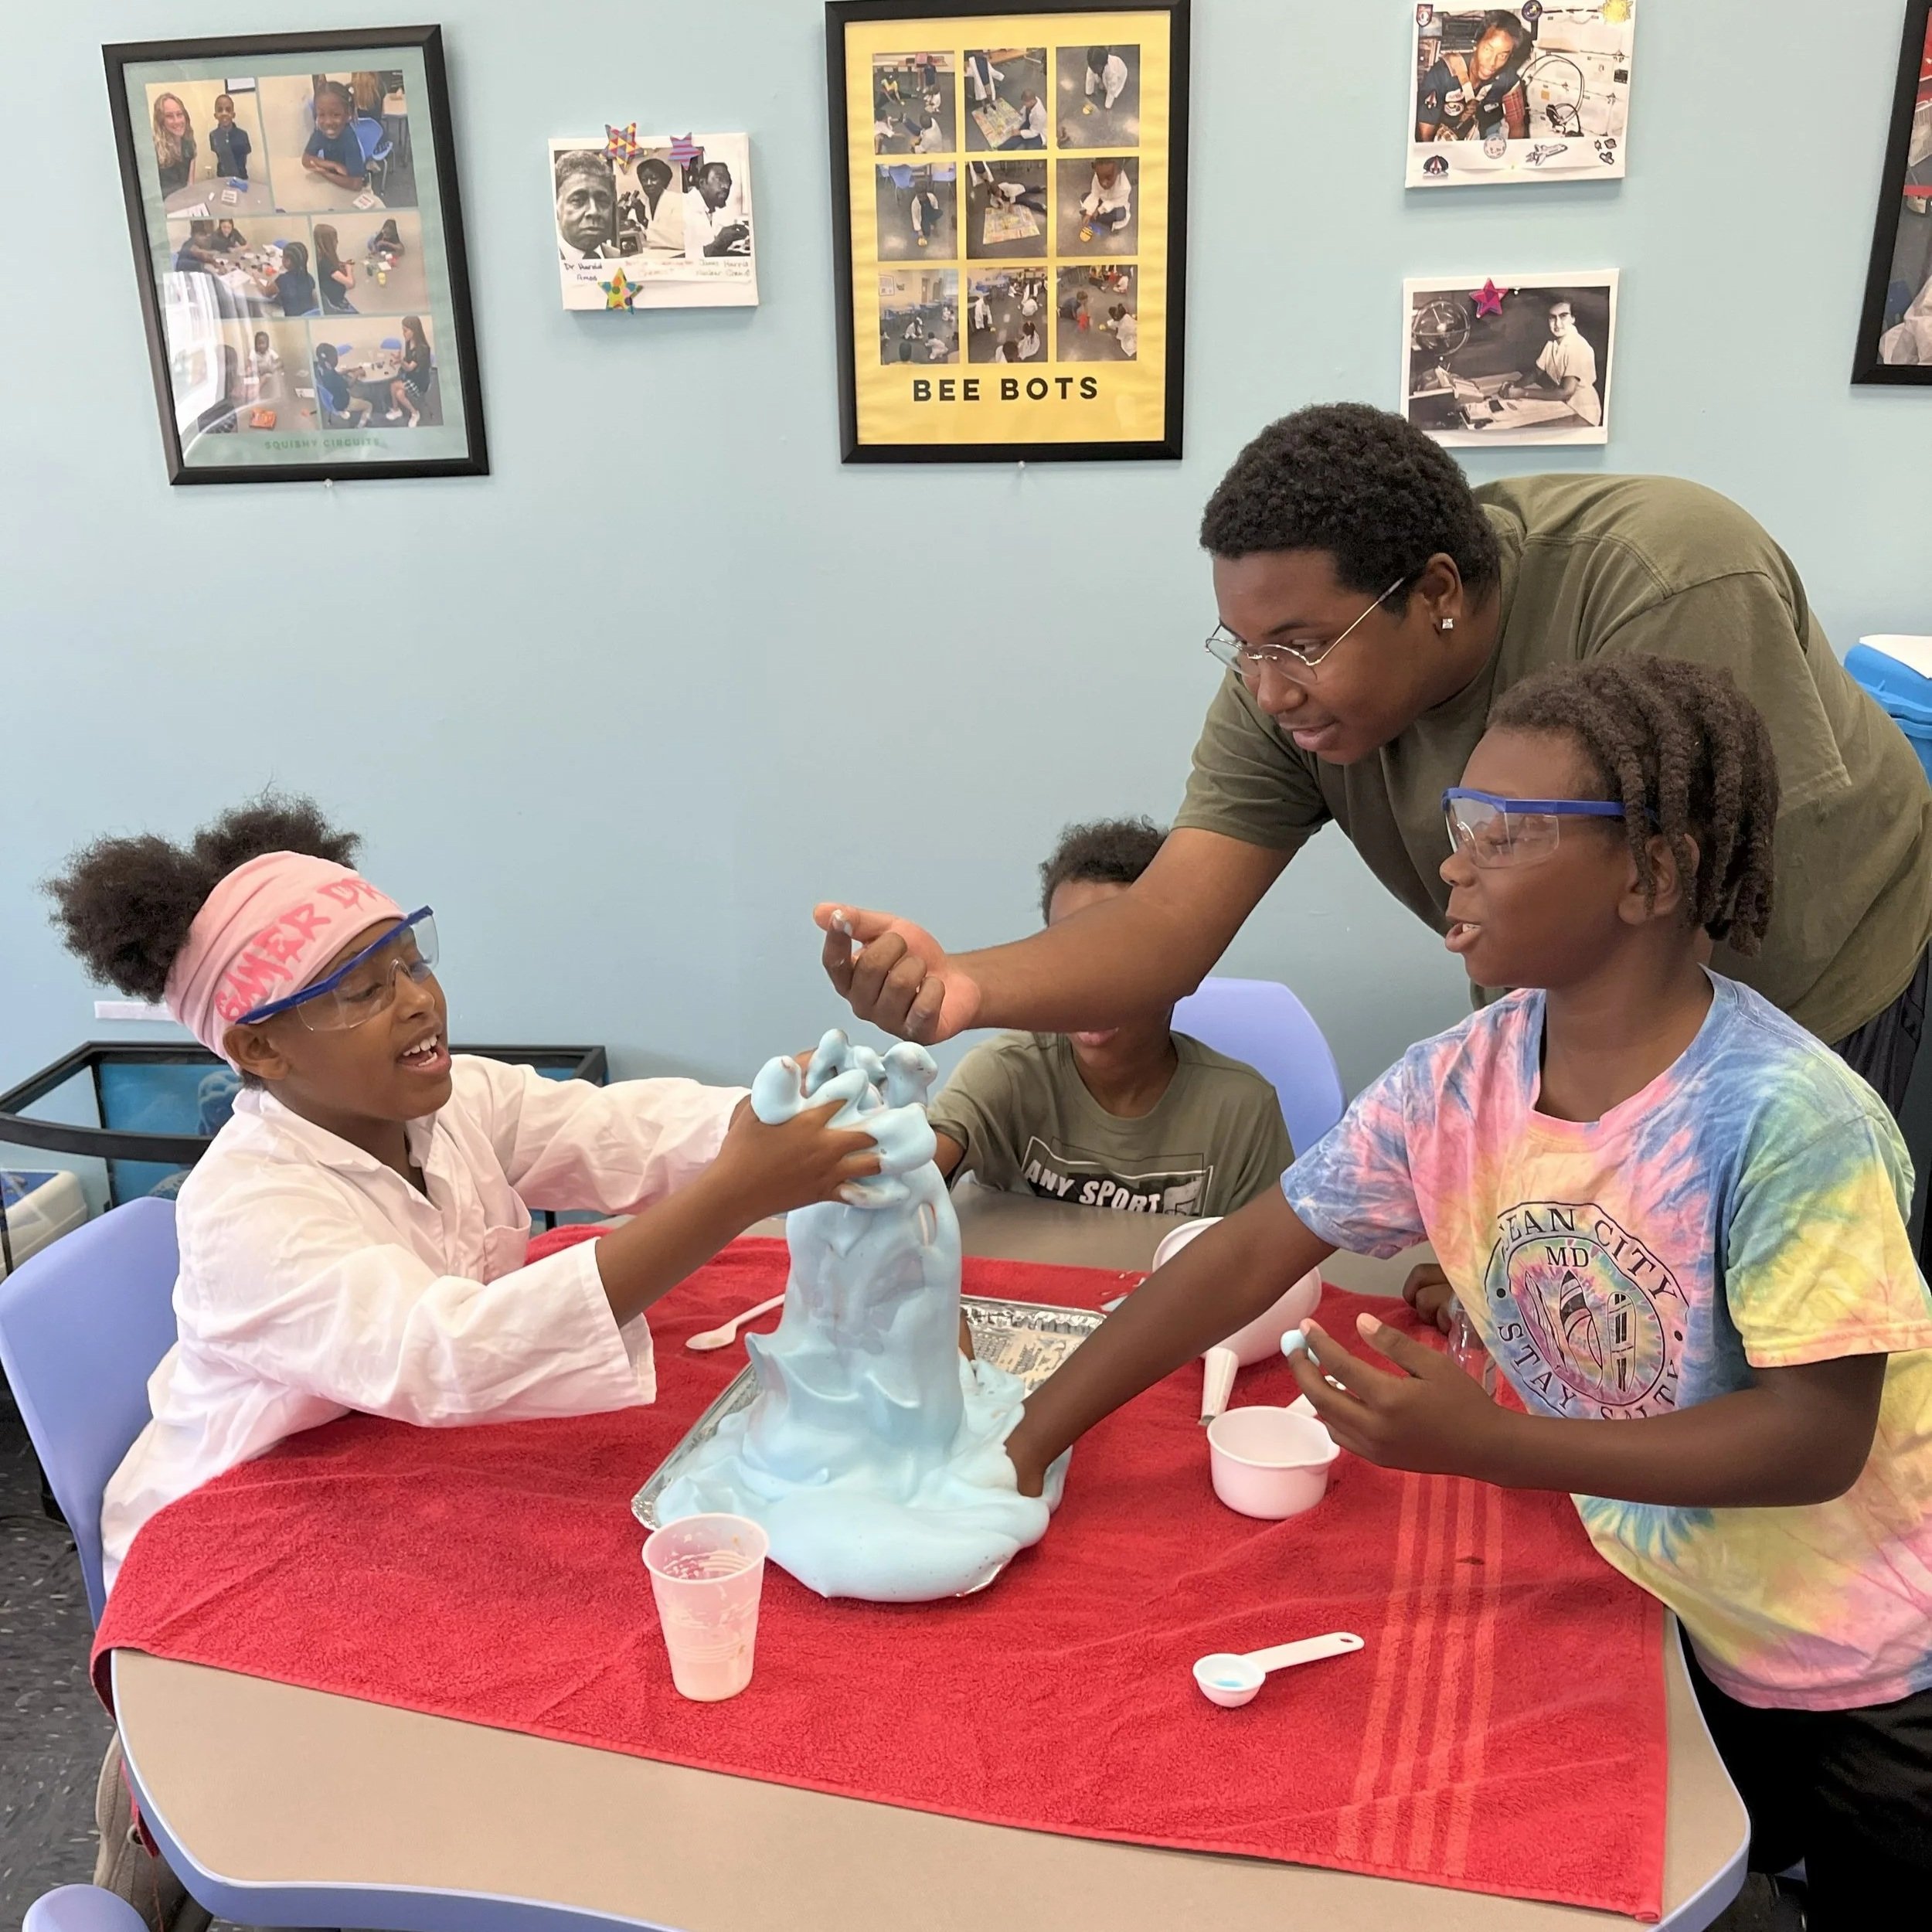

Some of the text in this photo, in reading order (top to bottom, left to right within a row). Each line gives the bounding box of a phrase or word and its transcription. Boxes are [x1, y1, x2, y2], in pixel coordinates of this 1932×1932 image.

[913, 376, 1098, 401] BEE BOTS
[264, 437, 380, 451] SQUISHY CIRCUITS
[1024, 1159, 1075, 1197] ANY
[1498, 1208, 1679, 1301] EAN CITY
[1544, 1245, 1590, 1267] MD
[1498, 1322, 1577, 1410] STAY
